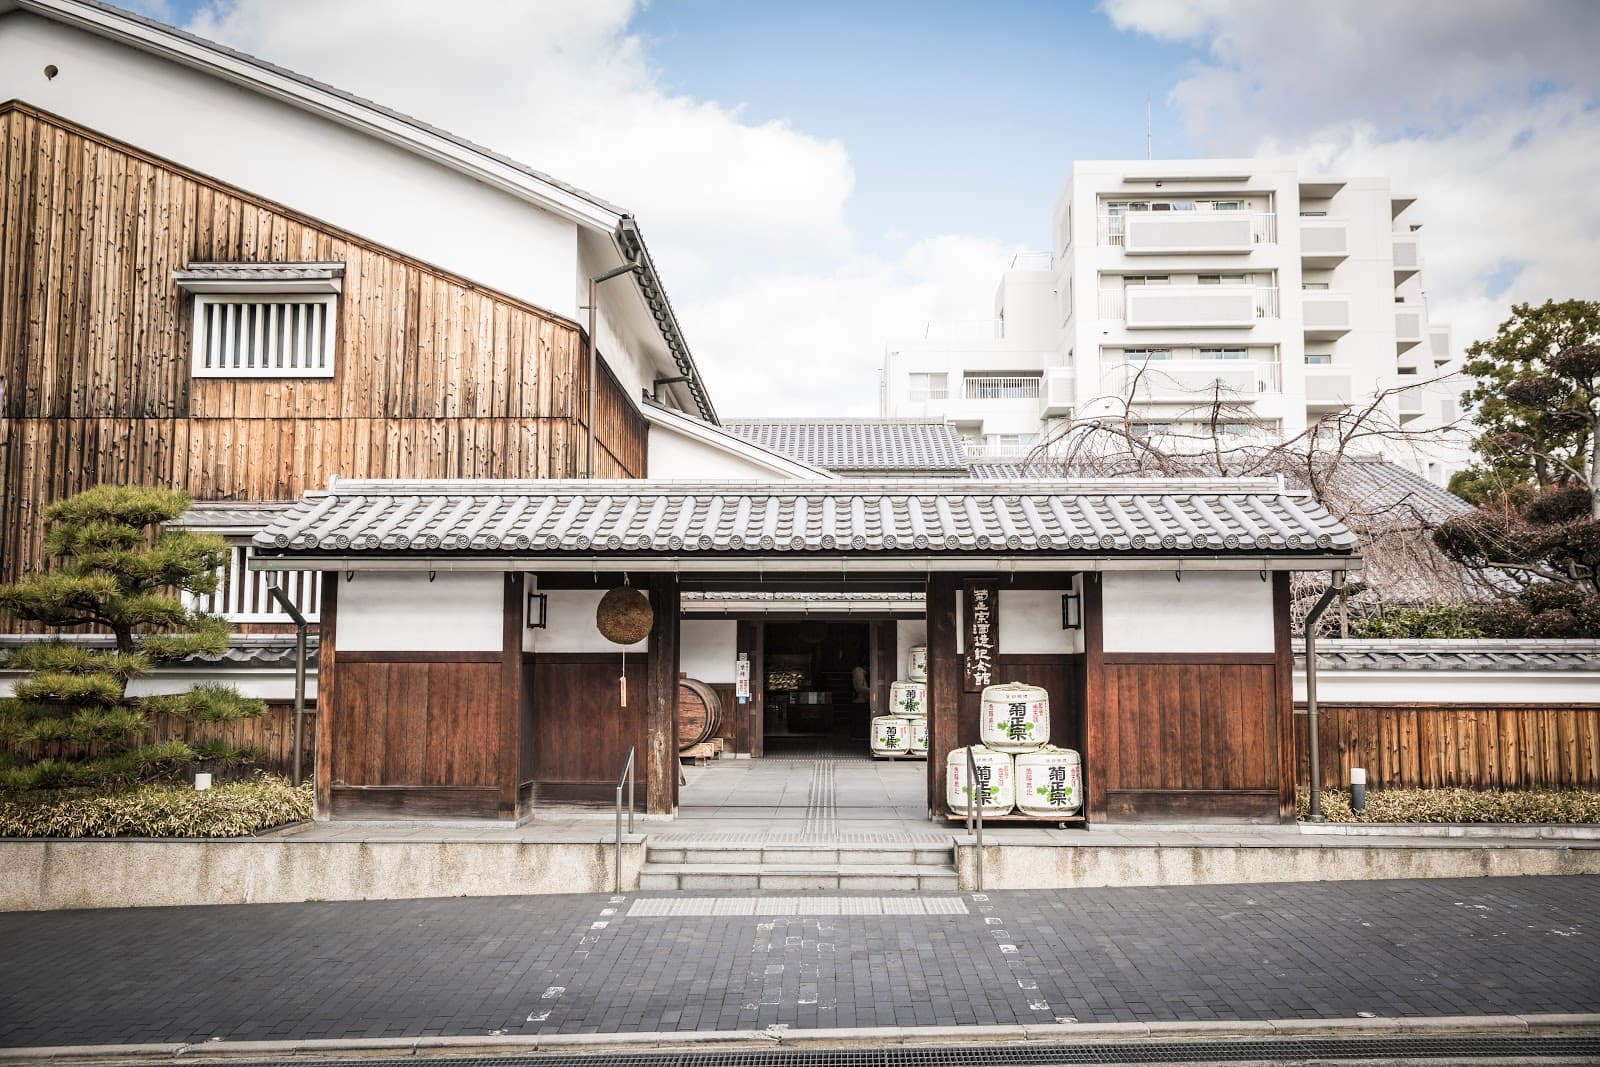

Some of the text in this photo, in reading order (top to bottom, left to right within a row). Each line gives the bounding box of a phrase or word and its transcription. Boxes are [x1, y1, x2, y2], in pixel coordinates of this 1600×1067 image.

[886, 726, 897, 749] 菊正宗
[1008, 702, 1028, 741] 菊正宗
[1048, 766, 1067, 806] 菊正宗
